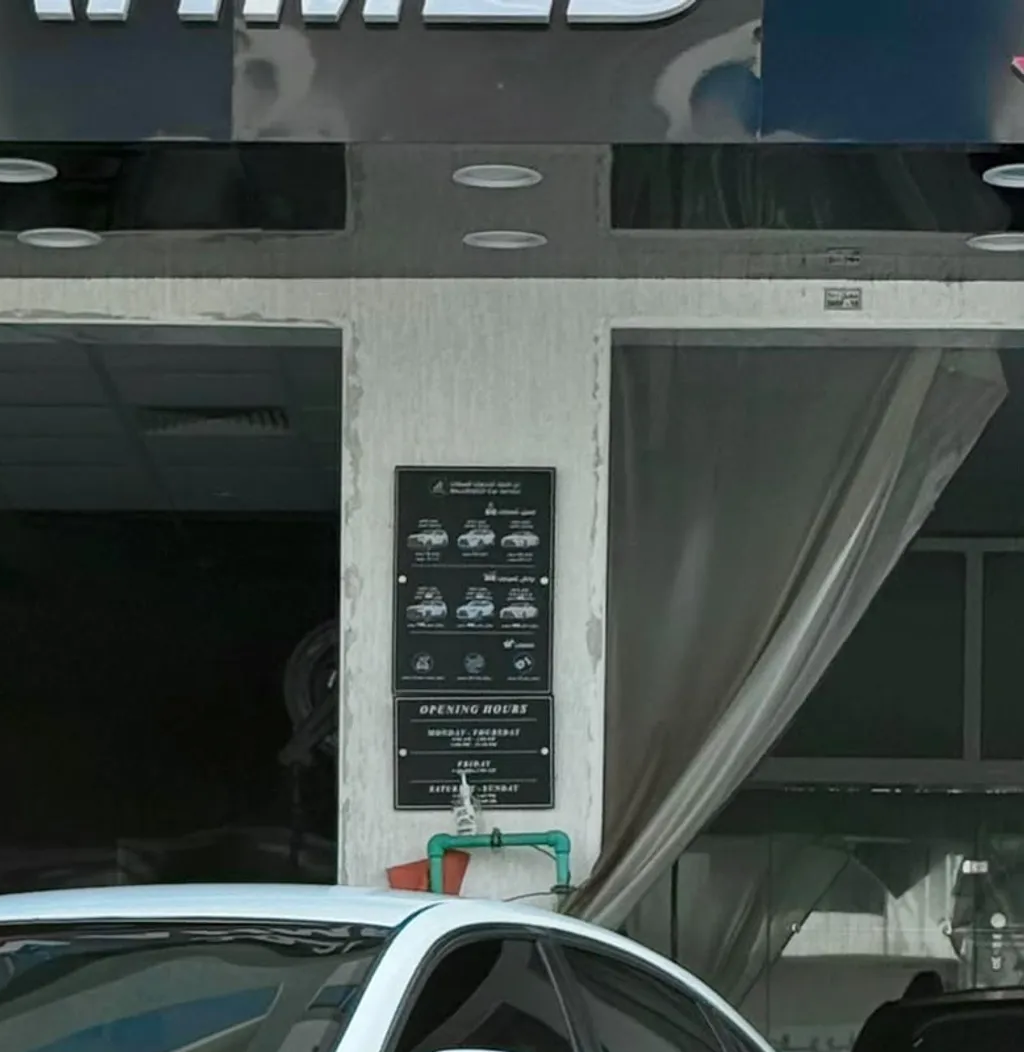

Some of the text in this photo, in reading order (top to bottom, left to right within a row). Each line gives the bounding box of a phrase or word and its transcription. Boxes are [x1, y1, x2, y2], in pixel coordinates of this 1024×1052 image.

[419, 704, 528, 715] OPENING HOURS
[427, 728, 467, 737] MONDAY
[456, 760, 492, 768] FRIDAY
[482, 784, 520, 793] SUNDAY
